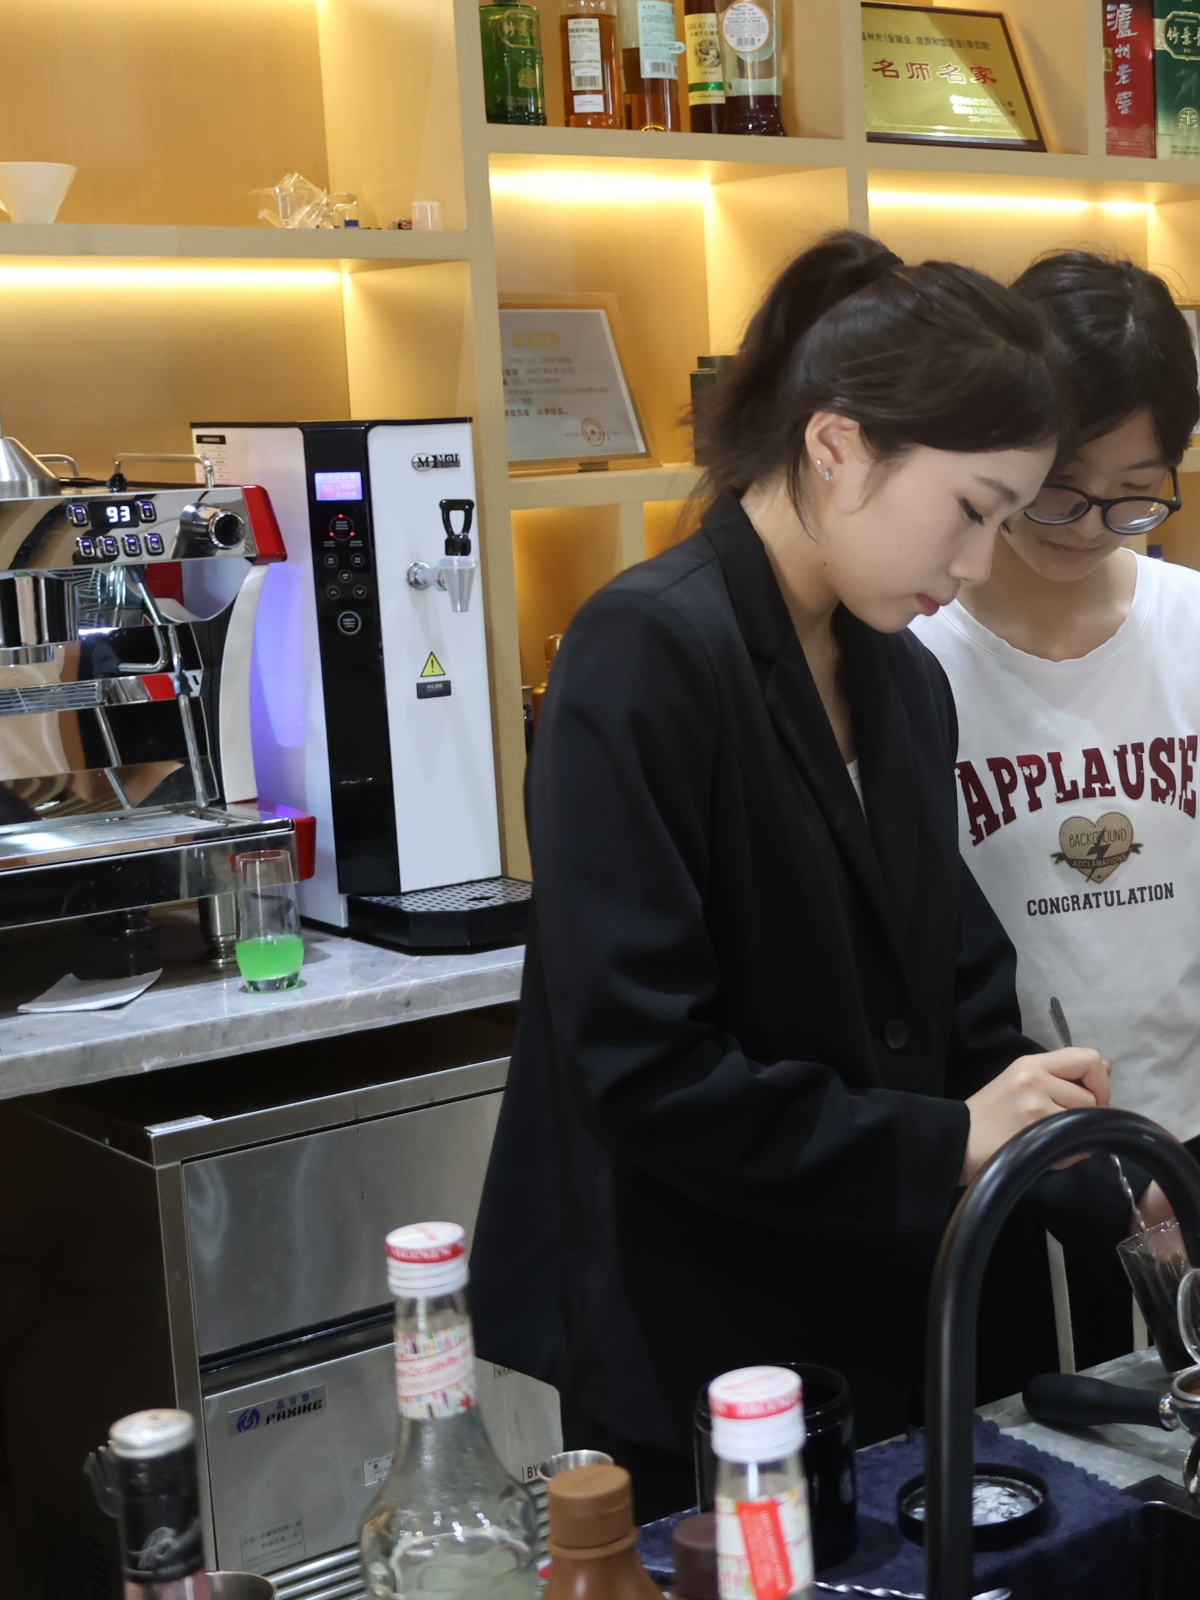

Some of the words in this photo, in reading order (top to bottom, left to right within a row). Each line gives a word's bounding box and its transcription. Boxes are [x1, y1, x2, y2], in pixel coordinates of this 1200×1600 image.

[872, 58, 998, 85] 名师名家
[106, 506, 131, 523] 93
[954, 735, 1198, 847] APPLAUSE
[1069, 828, 1127, 848] BACKGROUND
[1072, 853, 1127, 868] ACCLAMATIONS
[1026, 882, 1175, 917] CONGRATULATION
[266, 1399, 323, 1425] PAXIKE
